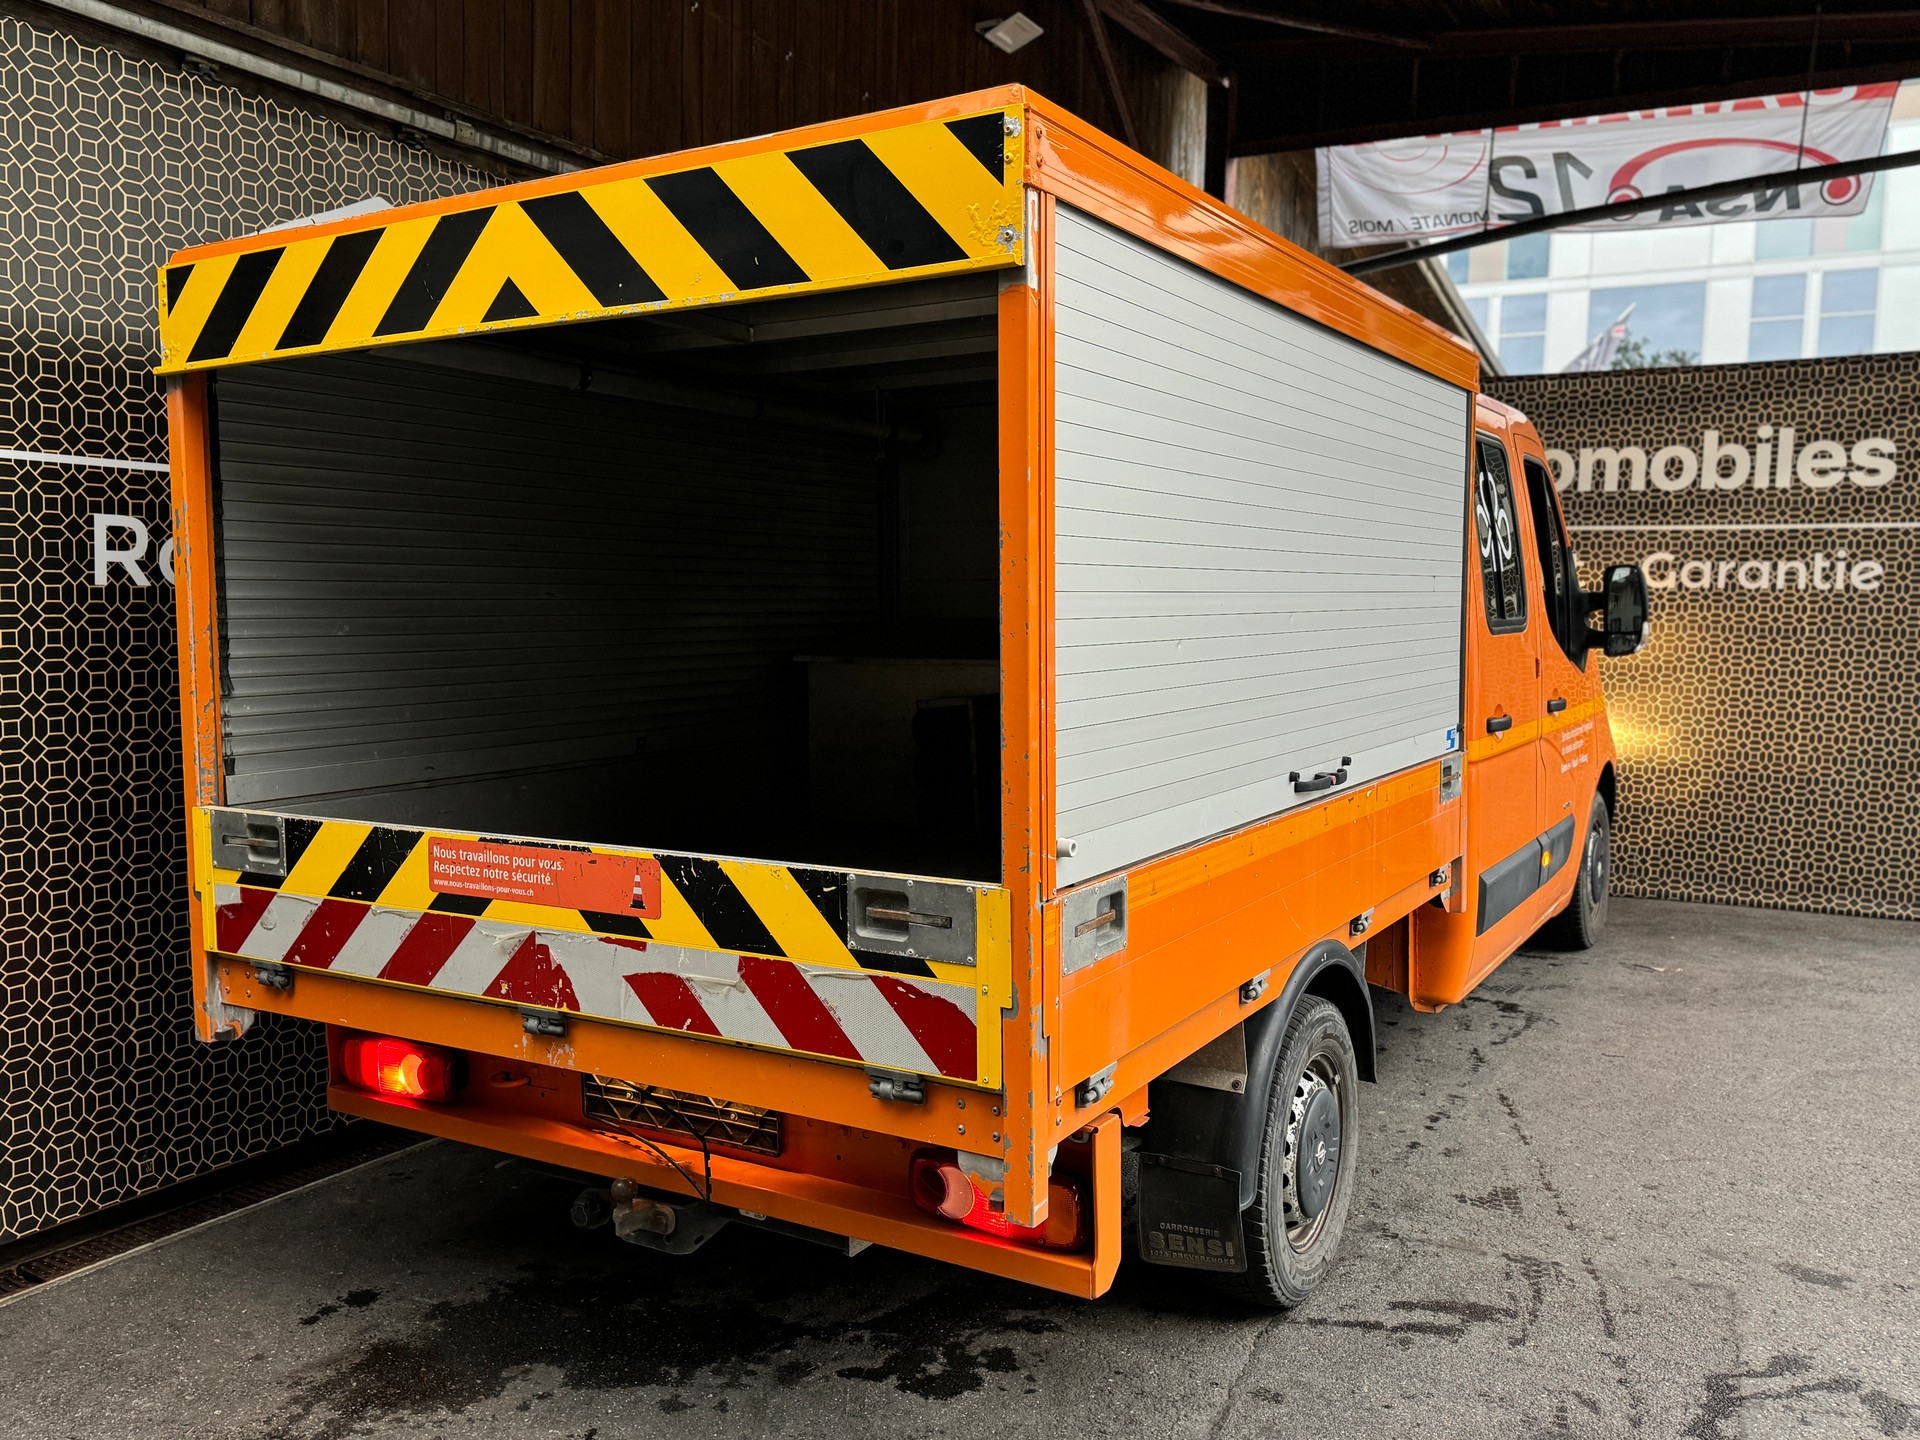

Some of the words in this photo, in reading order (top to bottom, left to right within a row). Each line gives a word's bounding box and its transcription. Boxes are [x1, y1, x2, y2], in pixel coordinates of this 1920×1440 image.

[1641, 549, 1884, 591] Garantie
[433, 845, 457, 859] Nous
[459, 848, 510, 865] travaillons
[512, 856, 536, 868] pour
[538, 859, 565, 871] vous.
[433, 861, 481, 877] Respectez
[483, 868, 509, 880] notre
[512, 870, 554, 886] sécurité.
[433, 878, 534, 896] www.nous-travaillons-pour-vous.ch
[1160, 1222, 1221, 1237] CARROSSERIE
[1148, 1231, 1234, 1257] SENSI
